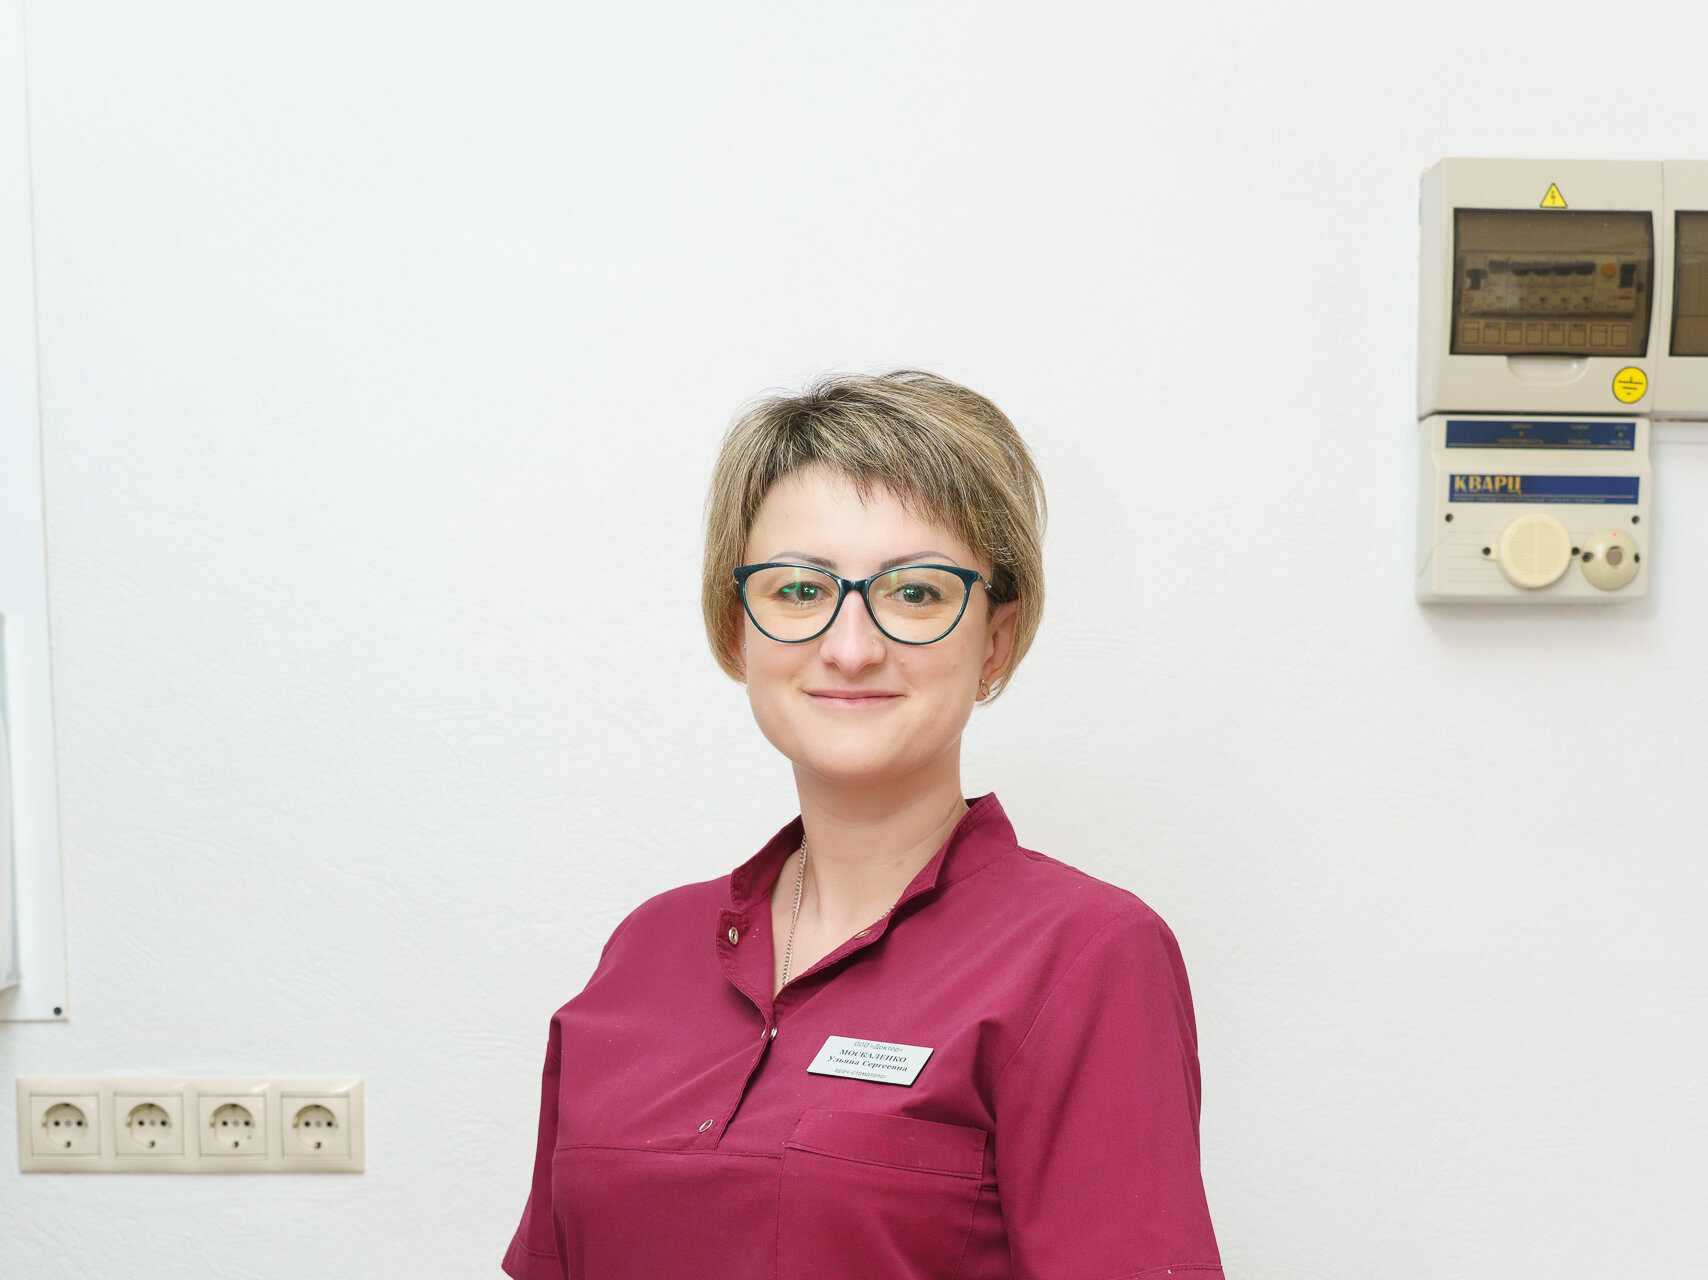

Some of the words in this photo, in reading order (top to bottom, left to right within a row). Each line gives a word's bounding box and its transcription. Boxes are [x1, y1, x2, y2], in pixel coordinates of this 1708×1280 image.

[1454, 475, 1522, 494] КВАРЦ
[870, 1043, 903, 1053] «Доктор»
[839, 1049, 907, 1063] МОСКАЛЕНКО
[827, 1056, 860, 1066] Ульяна
[862, 1060, 908, 1072] Сергеевна
